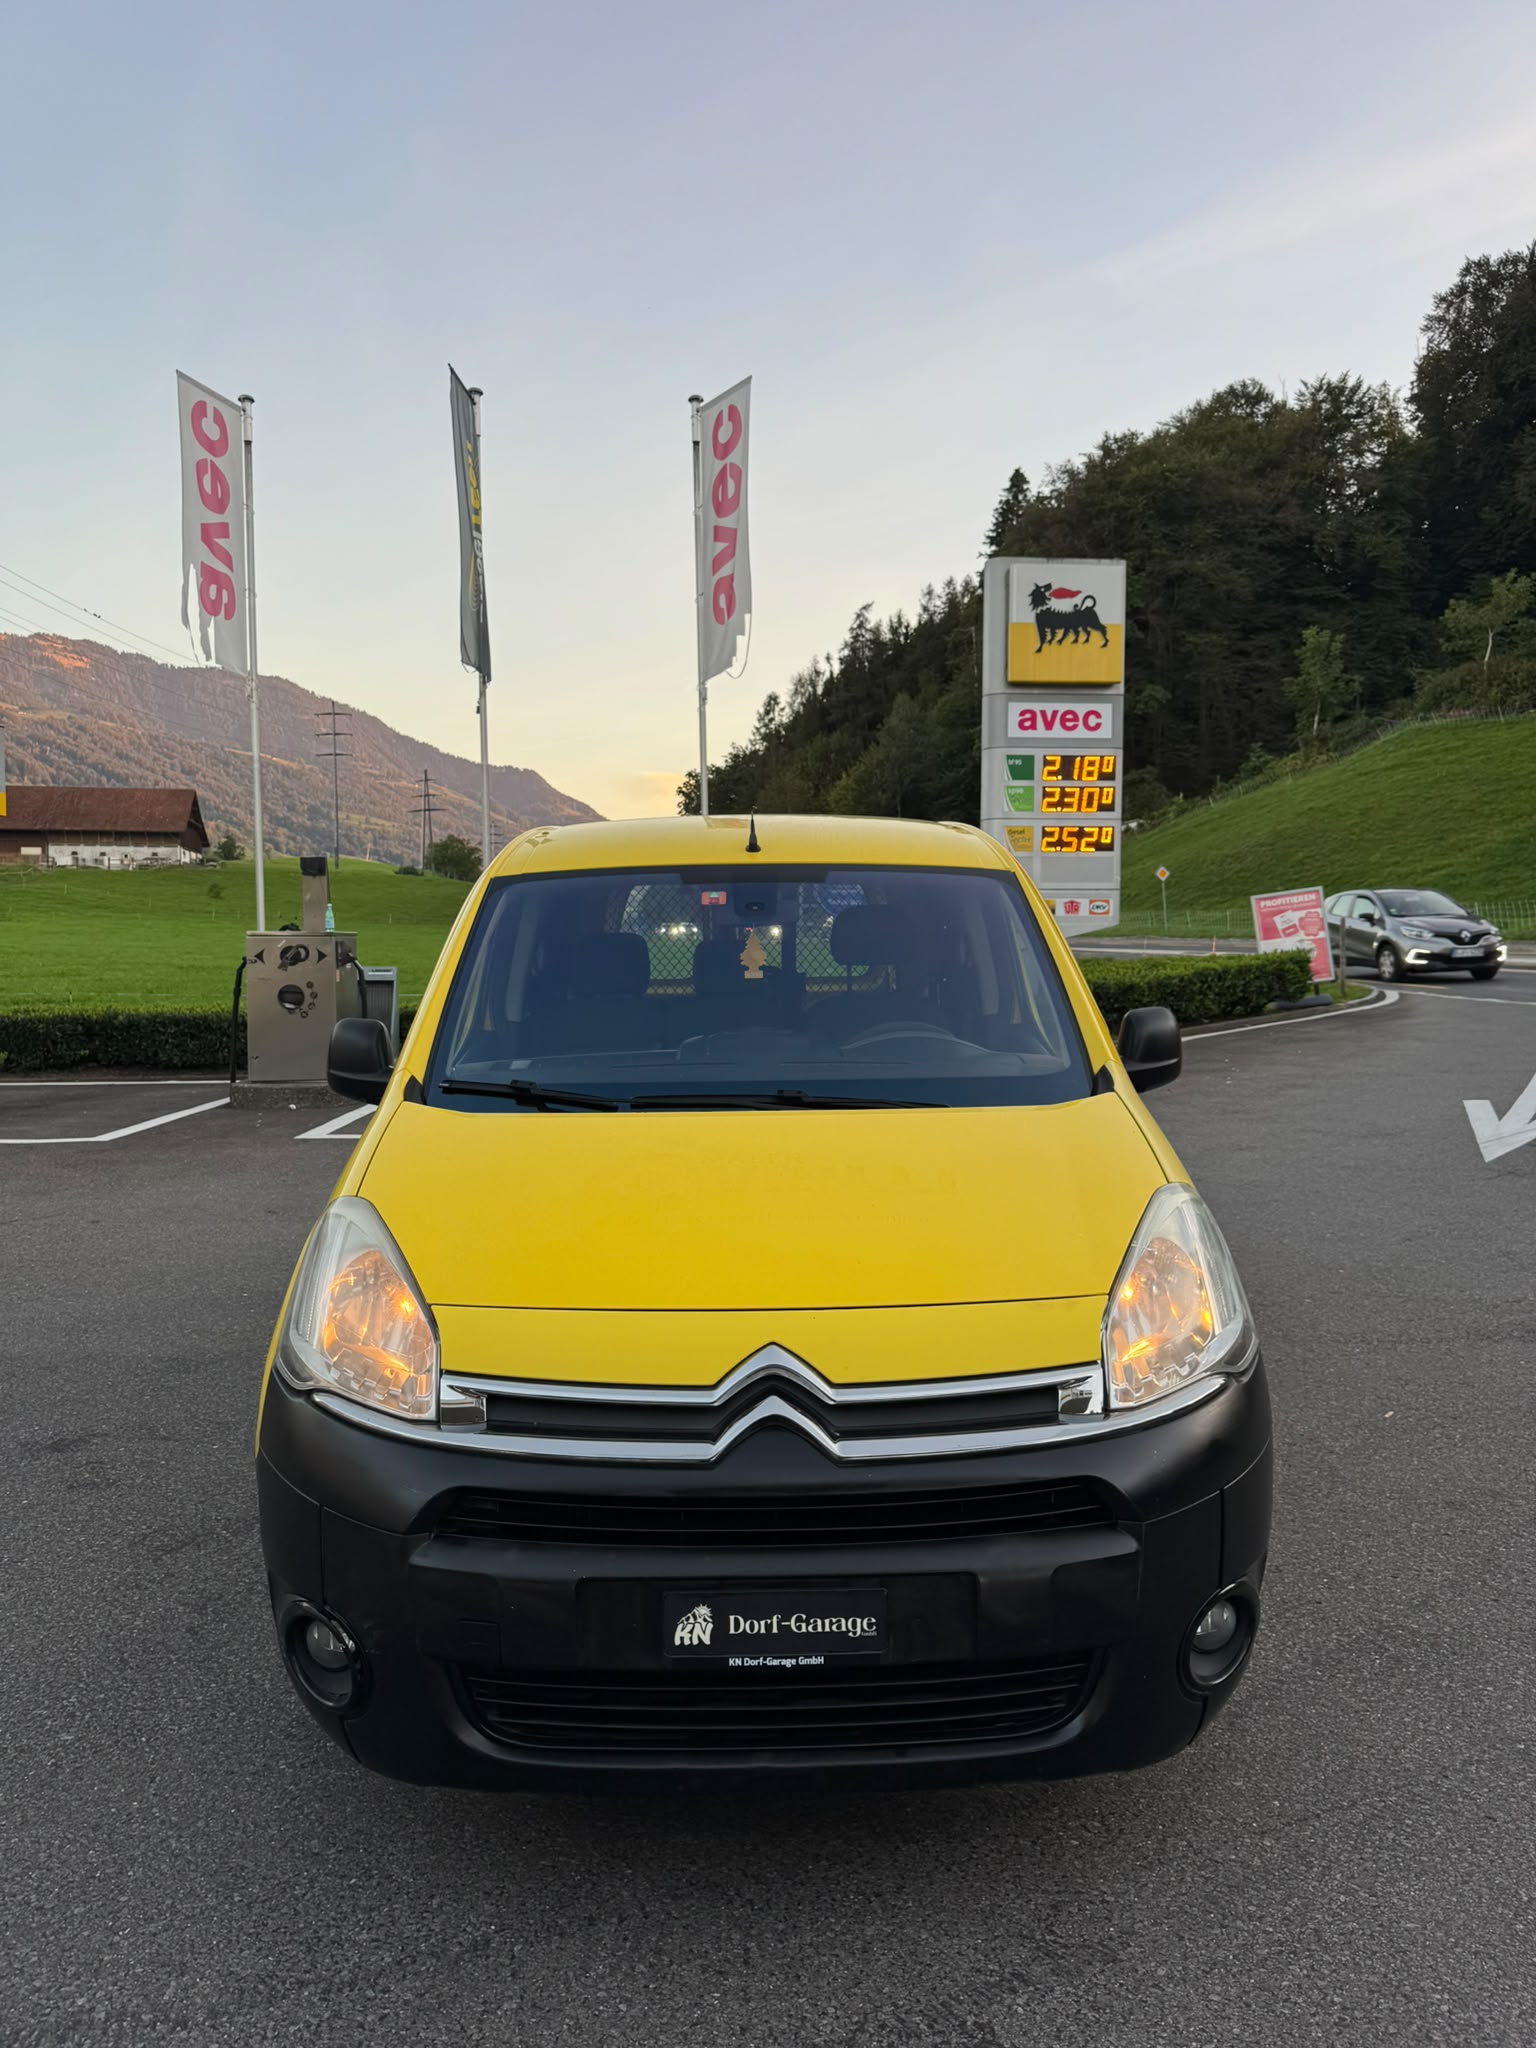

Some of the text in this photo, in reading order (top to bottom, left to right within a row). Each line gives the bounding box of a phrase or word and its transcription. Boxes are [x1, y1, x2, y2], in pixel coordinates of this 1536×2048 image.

[712, 403, 743, 626] avec
[1017, 708, 1103, 732] avec
[728, 1613, 877, 1638] Dorf-Garage
[728, 1655, 825, 1668] KN Dorf-Garage GmbH
